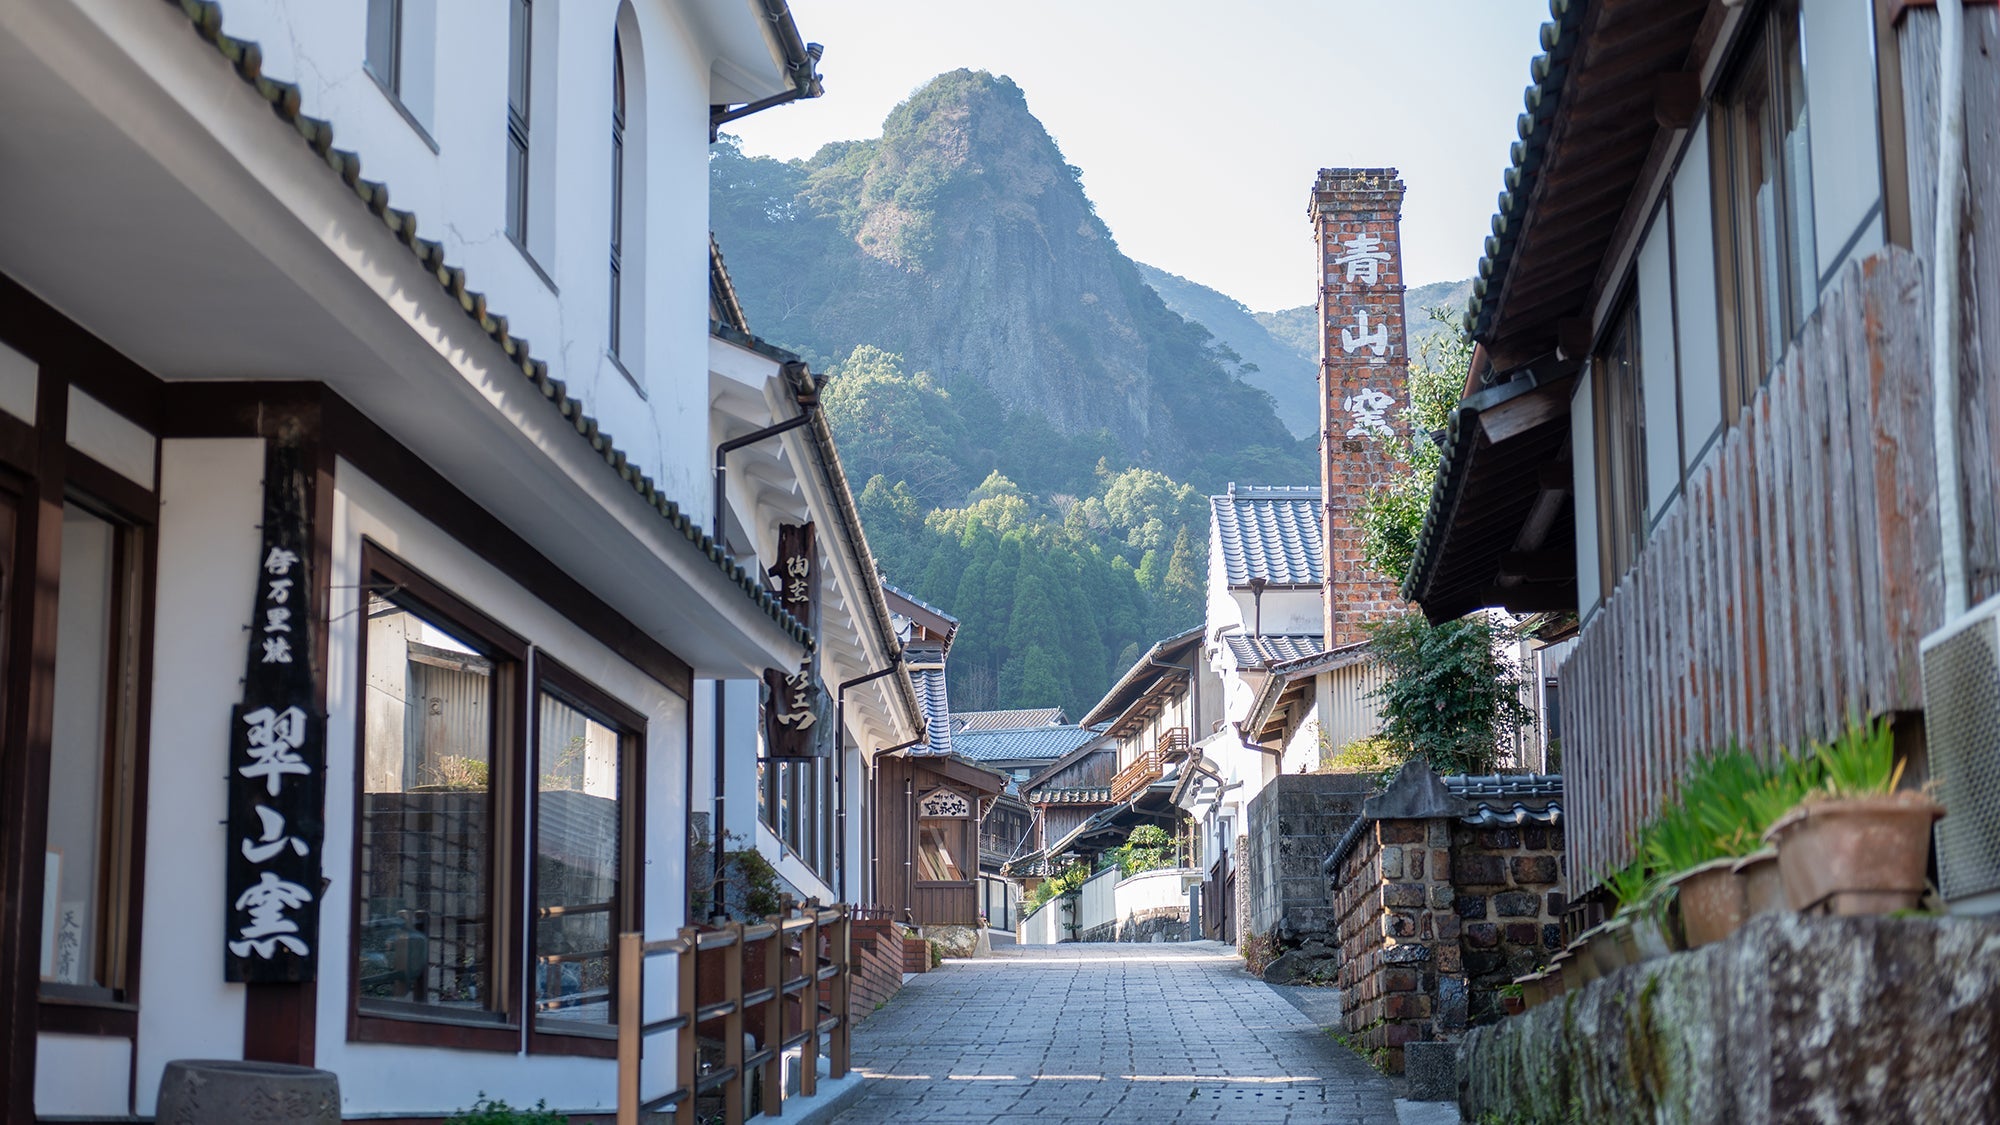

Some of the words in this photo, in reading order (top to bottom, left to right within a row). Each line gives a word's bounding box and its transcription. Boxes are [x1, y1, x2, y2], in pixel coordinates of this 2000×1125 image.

[1335, 233, 1396, 440] 青山窯
[228, 705, 313, 960] 翠山窯
[58, 910, 80, 984] 天然青
